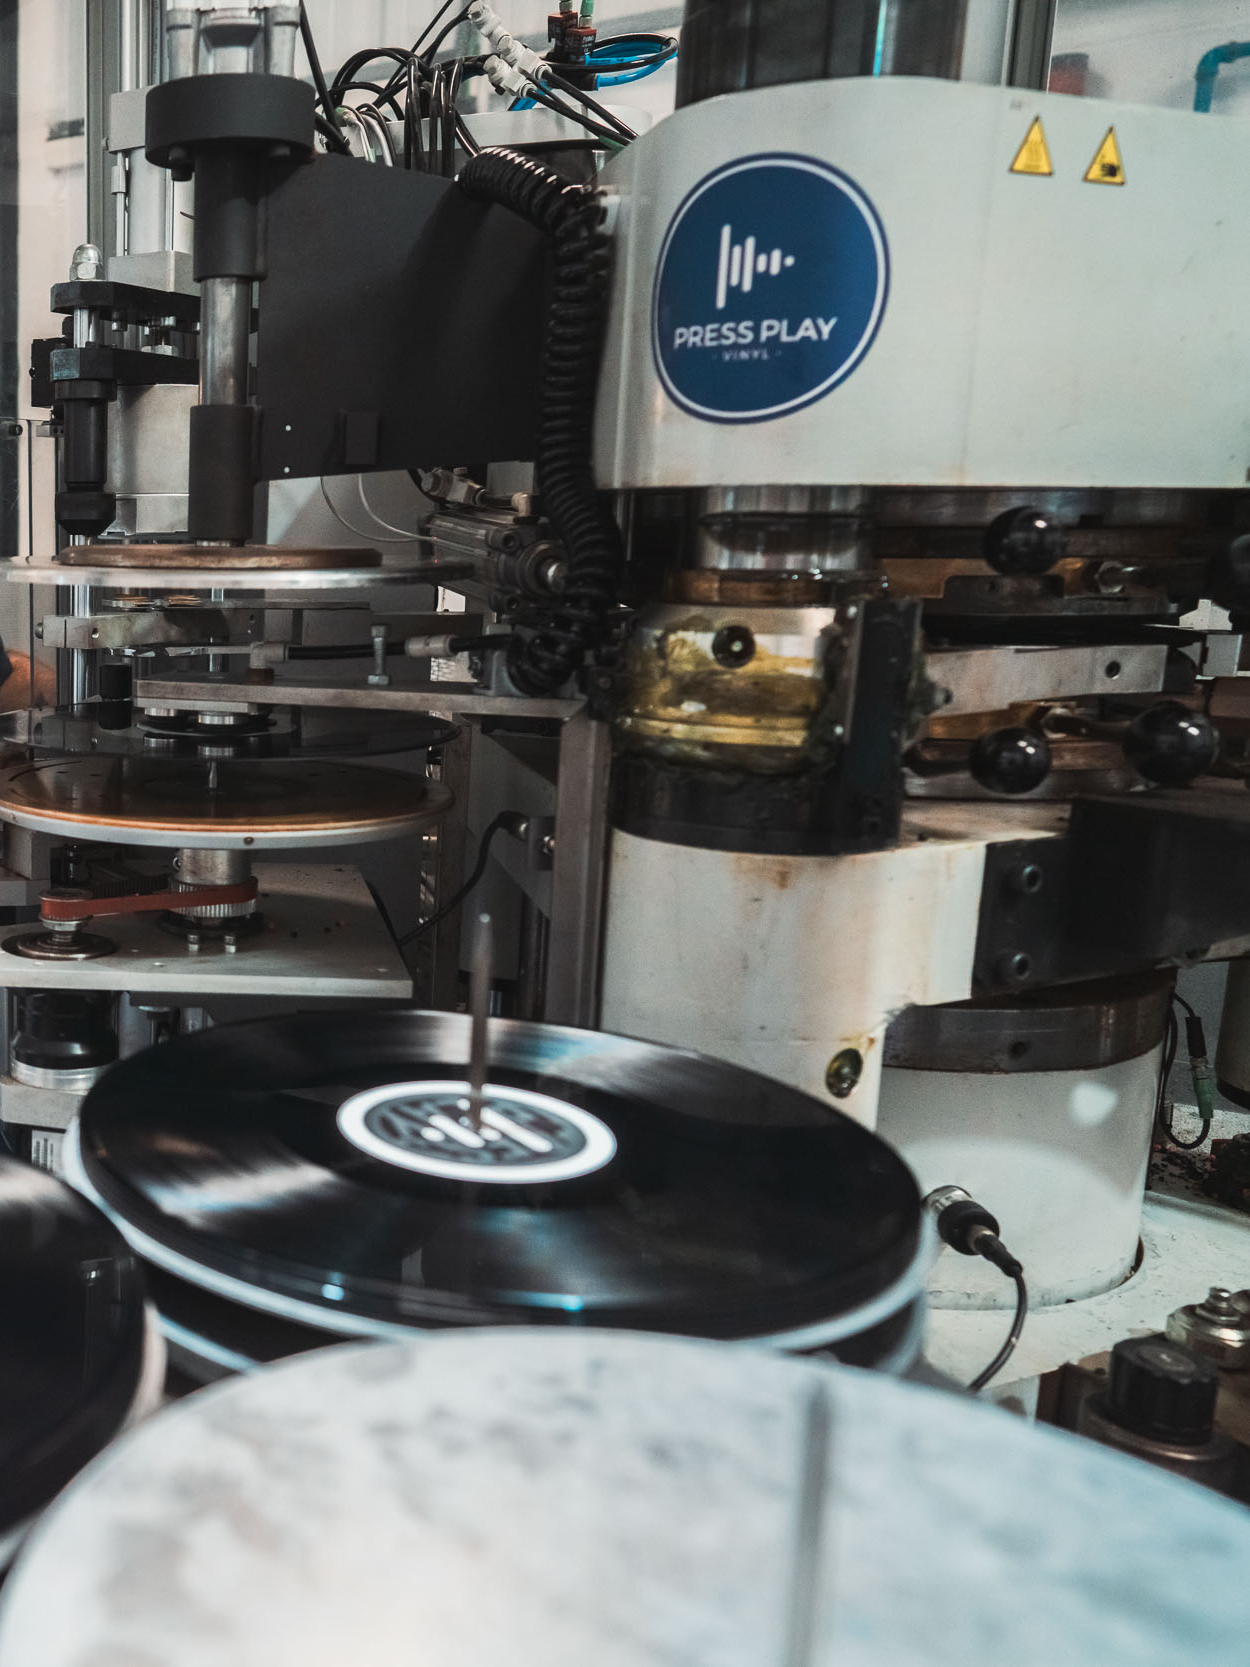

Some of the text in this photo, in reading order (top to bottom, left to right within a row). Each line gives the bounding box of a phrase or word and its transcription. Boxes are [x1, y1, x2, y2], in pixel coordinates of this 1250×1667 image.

[673, 317, 837, 349] PRESS PLAY
[721, 348, 769, 361] VINYL
